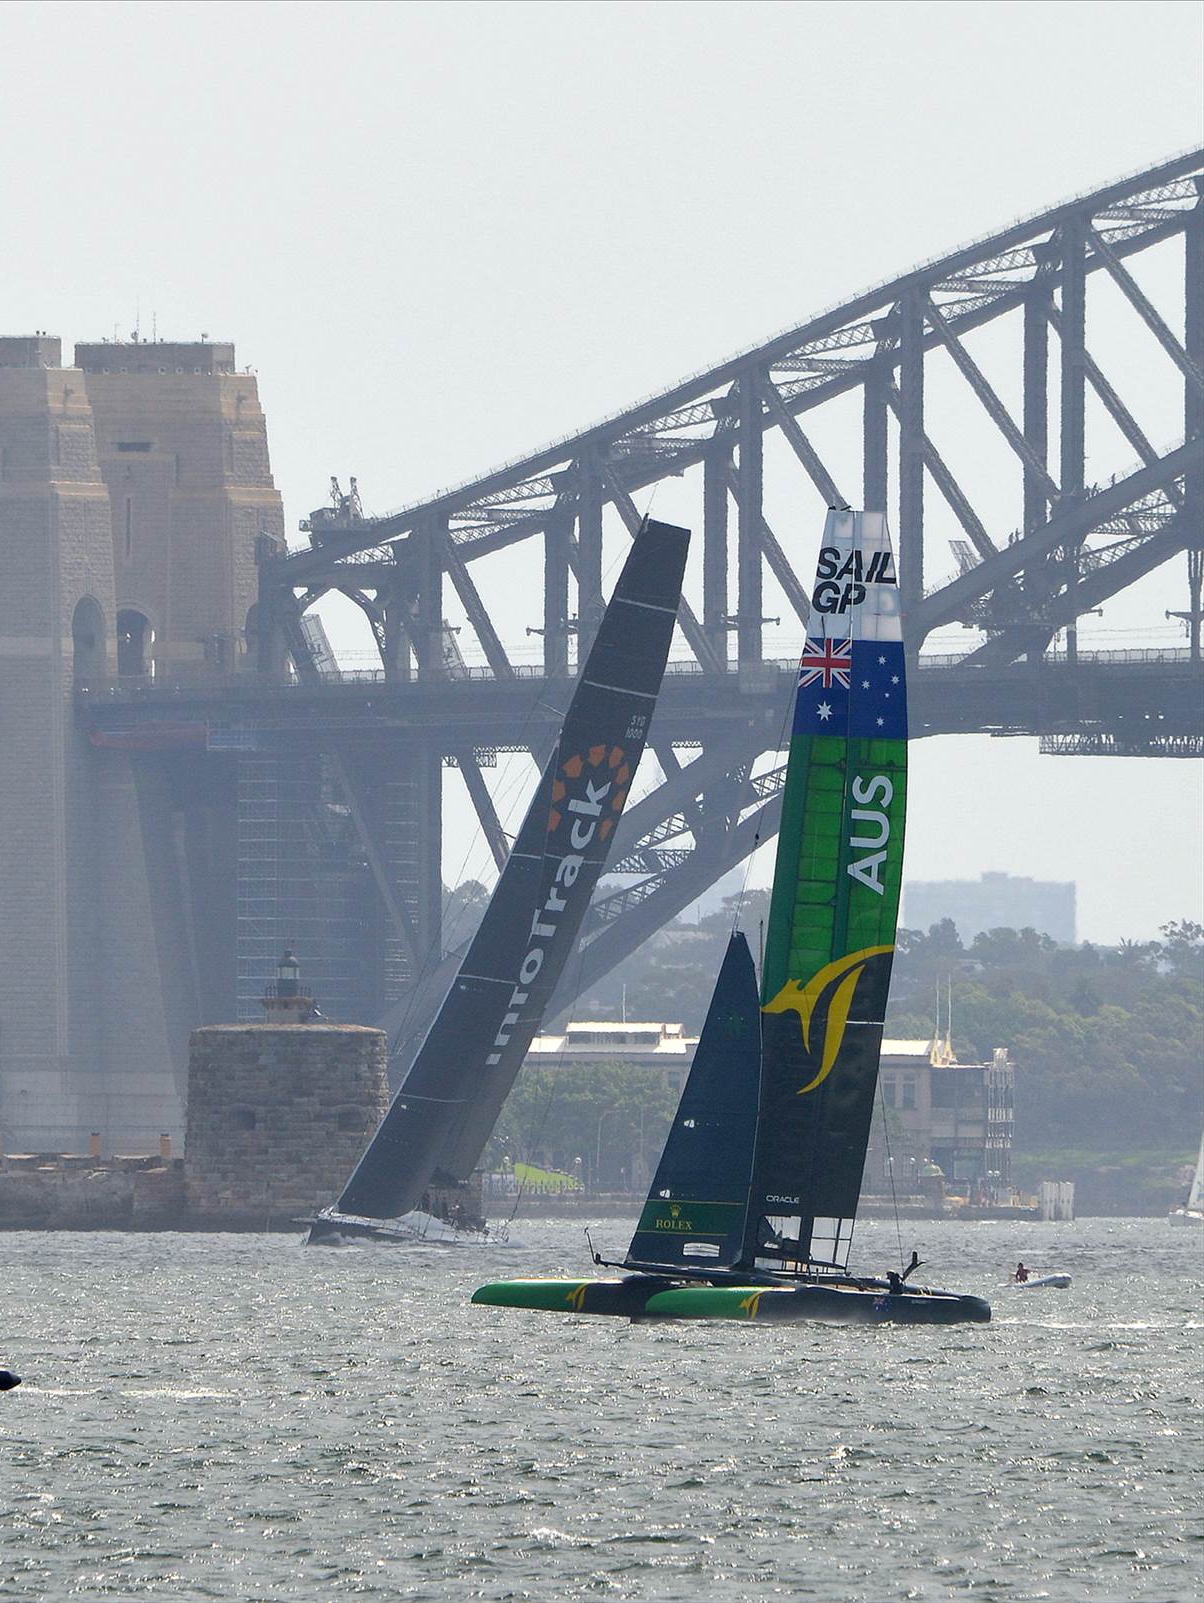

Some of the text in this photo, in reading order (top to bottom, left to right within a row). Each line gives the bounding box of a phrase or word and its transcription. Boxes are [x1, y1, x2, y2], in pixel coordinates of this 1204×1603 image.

[816, 547, 896, 584] SAIL
[811, 581, 867, 614] GP
[847, 775, 893, 896] AUS
[765, 1195, 800, 1205] ORACLE
[656, 1219, 692, 1231] ROLEX
